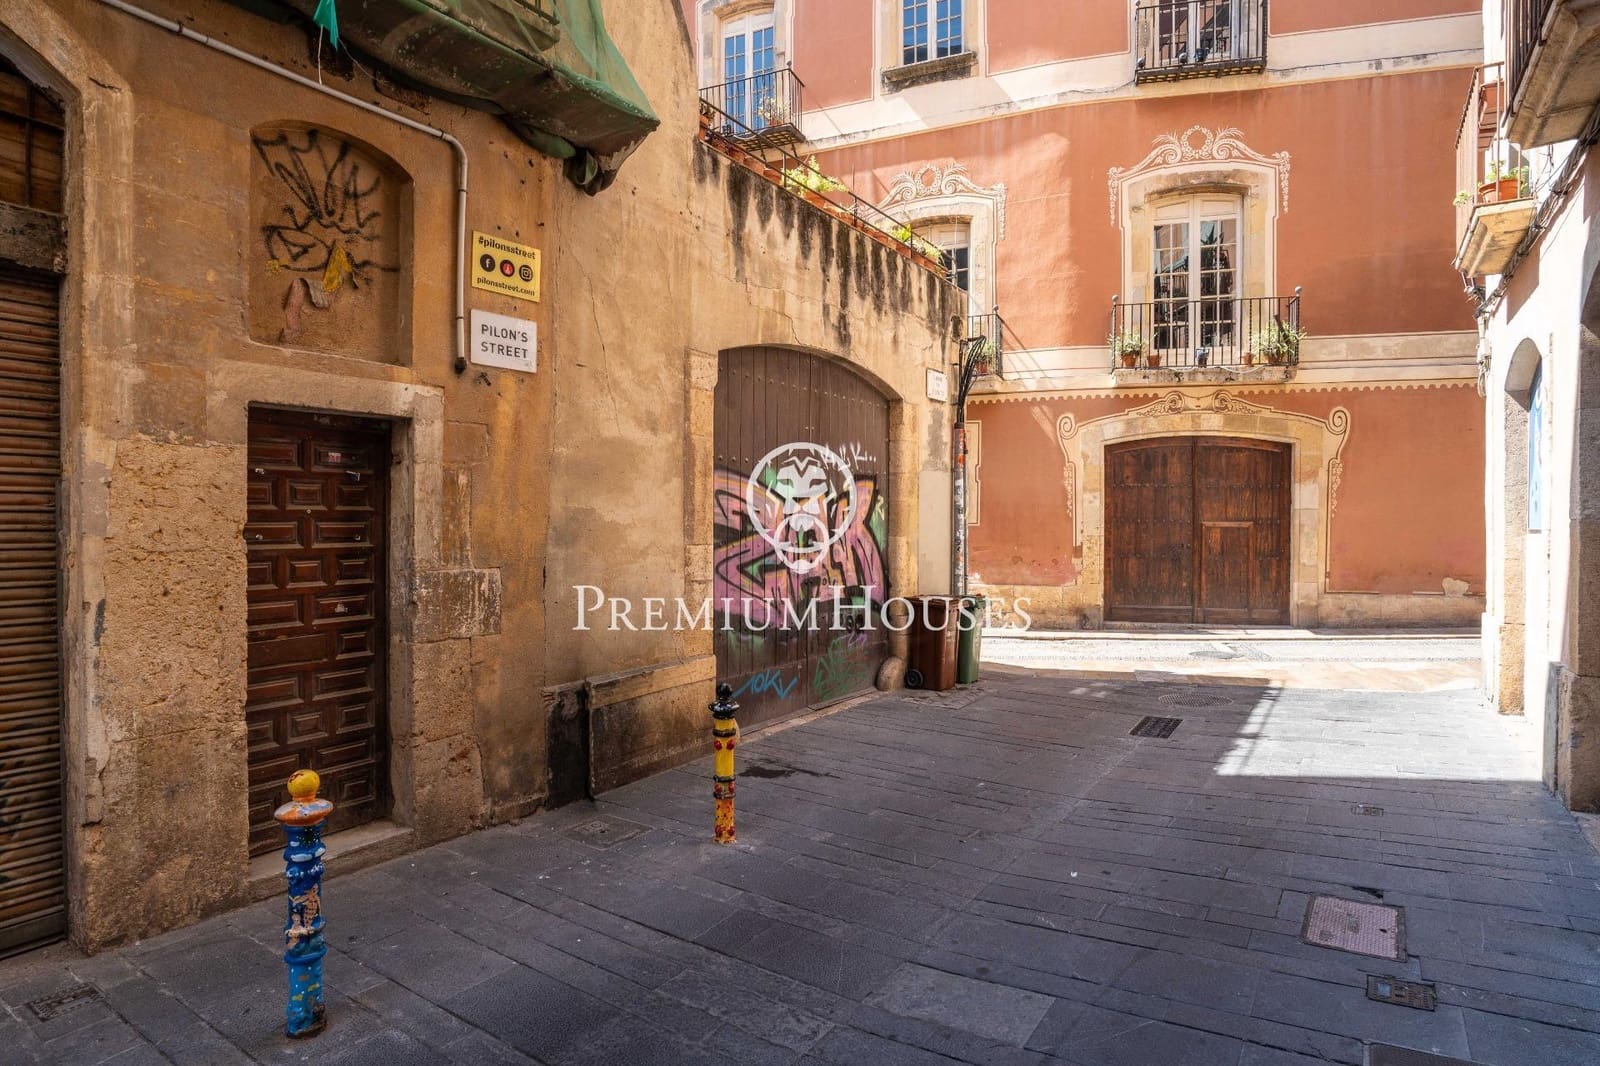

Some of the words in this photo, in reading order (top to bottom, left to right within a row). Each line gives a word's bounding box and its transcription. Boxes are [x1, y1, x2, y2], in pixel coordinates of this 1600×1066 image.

[478, 235, 536, 260] #pilonsstreet
[476, 276, 535, 297] pilonsstreet.com
[481, 324, 529, 343] PILON'S
[480, 341, 529, 359] STREET
